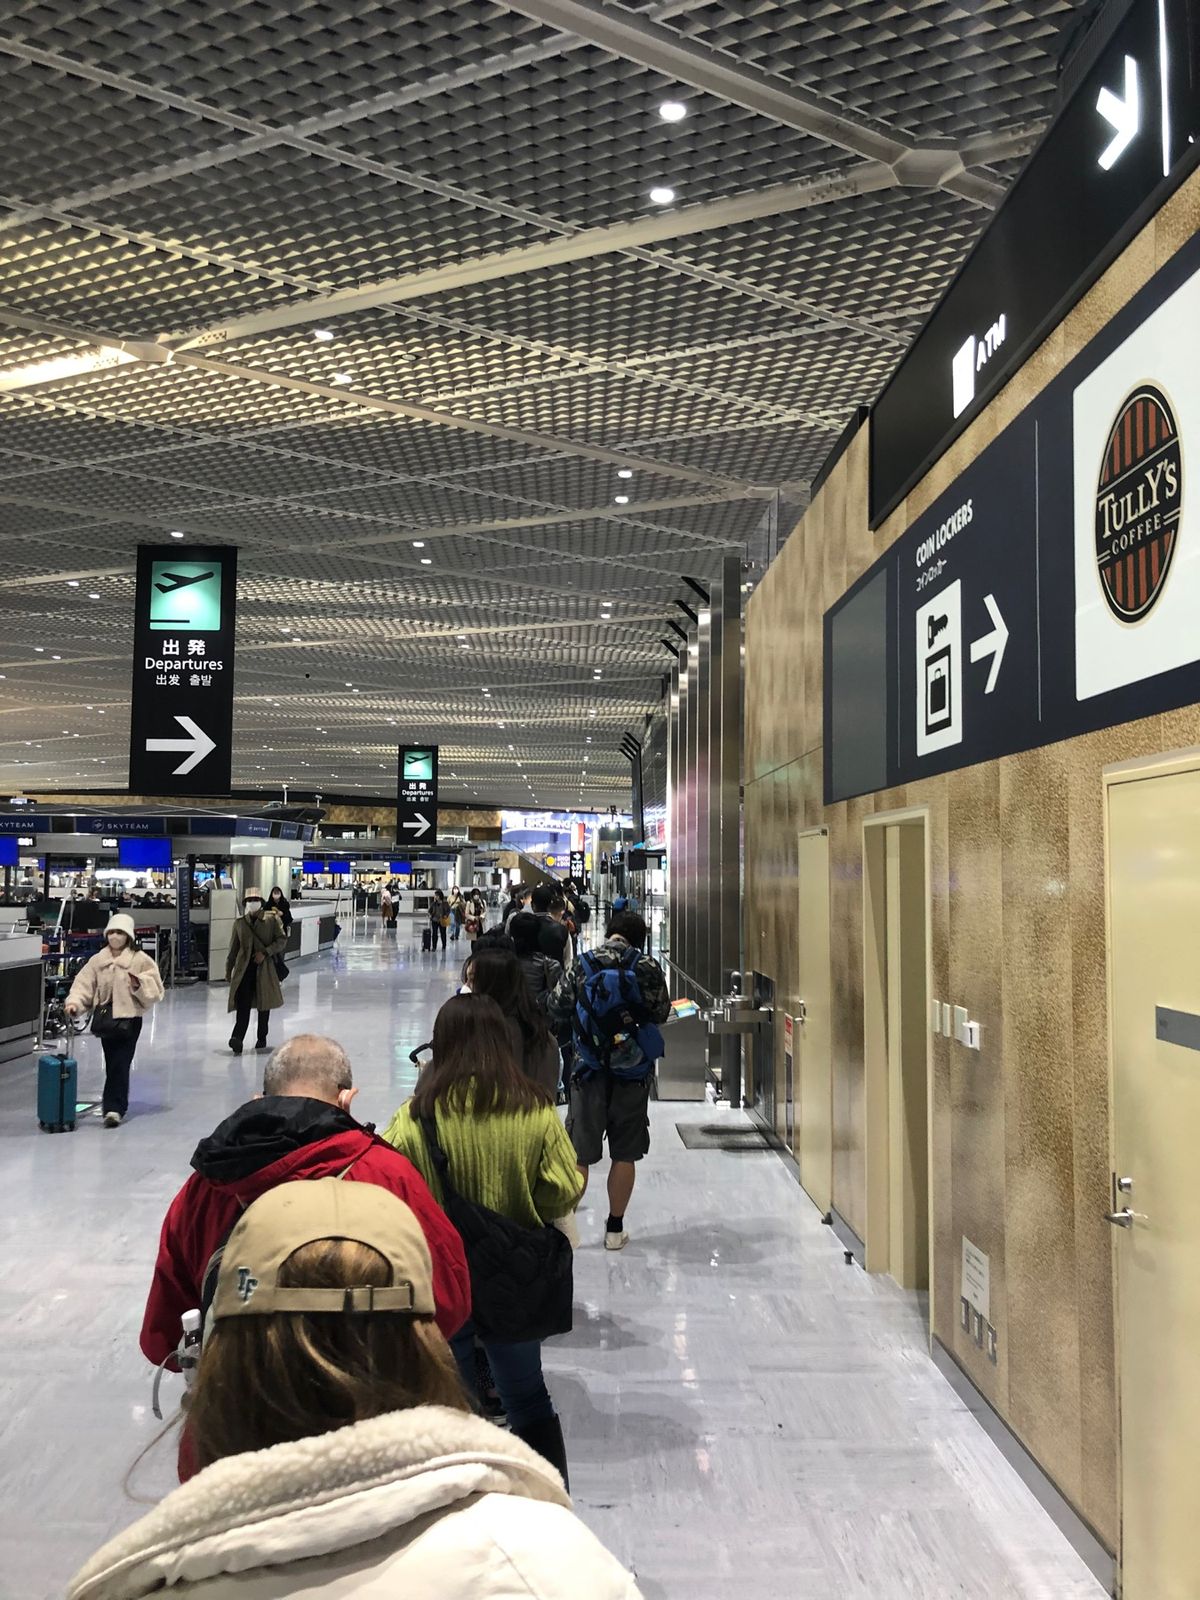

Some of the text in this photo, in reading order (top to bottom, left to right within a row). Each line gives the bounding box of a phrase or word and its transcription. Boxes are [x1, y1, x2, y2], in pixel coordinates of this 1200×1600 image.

[977, 313, 1006, 372] ATM
[1098, 458, 1178, 540] TULLY'S
[916, 498, 974, 568] COIN LOCKERS
[1111, 512, 1162, 556] COFFEE
[145, 657, 224, 673] Departures
[155, 674, 181, 686] 出发
[401, 789, 434, 797] Departures
